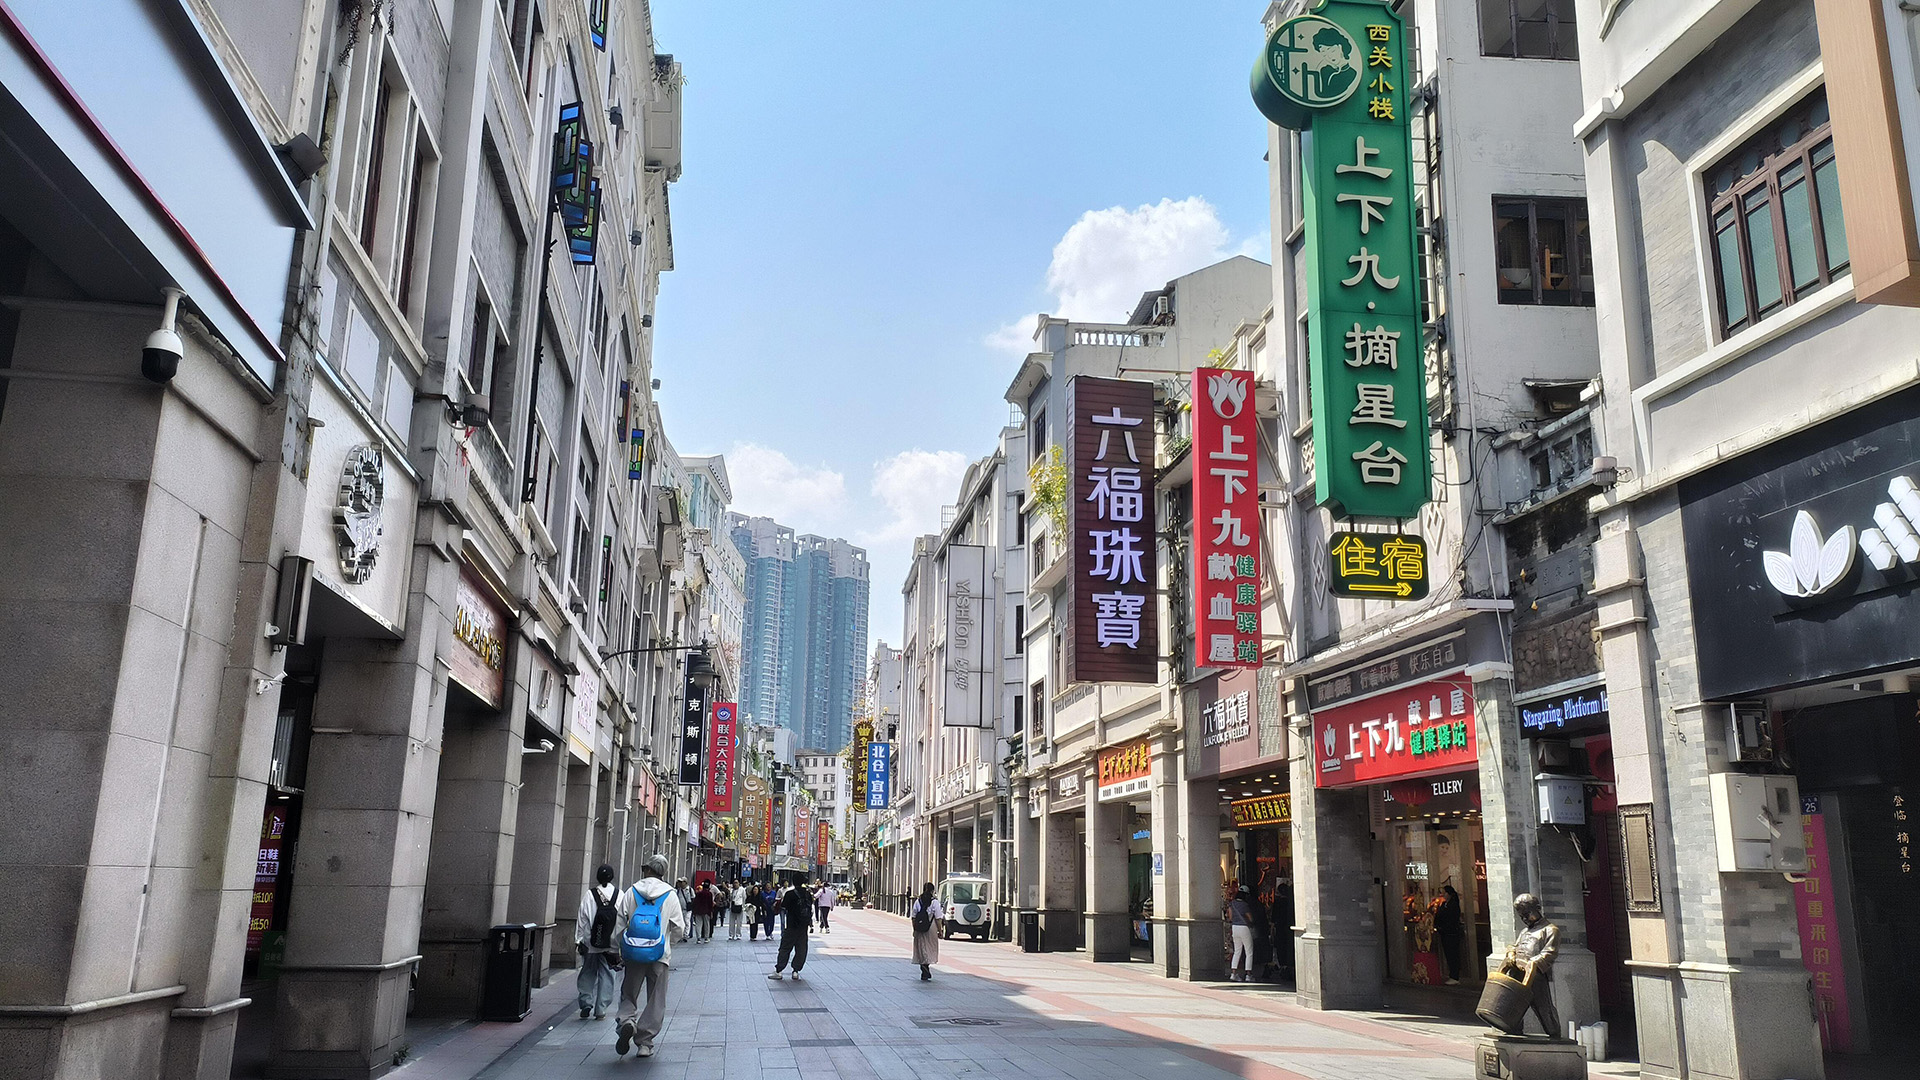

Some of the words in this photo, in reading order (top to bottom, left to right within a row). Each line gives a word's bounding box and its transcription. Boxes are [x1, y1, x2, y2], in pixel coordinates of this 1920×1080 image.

[1366, 24, 1395, 120] 西关小栈
[1086, 407, 1147, 649] 六福珠寶
[1331, 536, 1424, 580] 住宿
[1235, 554, 1258, 663] 健康驿站
[1409, 643, 1456, 676] 快乐自己
[685, 677, 701, 767] 克斯顿
[1203, 690, 1249, 735] 六福珠寶
[1408, 689, 1466, 726] 献血屋
[1523, 703, 1564, 731] Stargazing
[1563, 696, 1600, 720] Platform
[1344, 712, 1405, 761] 上下九
[1410, 720, 1467, 757] 健康驿站
[1431, 780, 1463, 796] ELLERY
[744, 793, 756, 840] 中国黄金
[1242, 799, 1290, 821] 下九路百货商店
[1805, 802, 1817, 812] 25
[798, 821, 806, 855] 中国黄金
[1405, 862, 1428, 875] 六福
